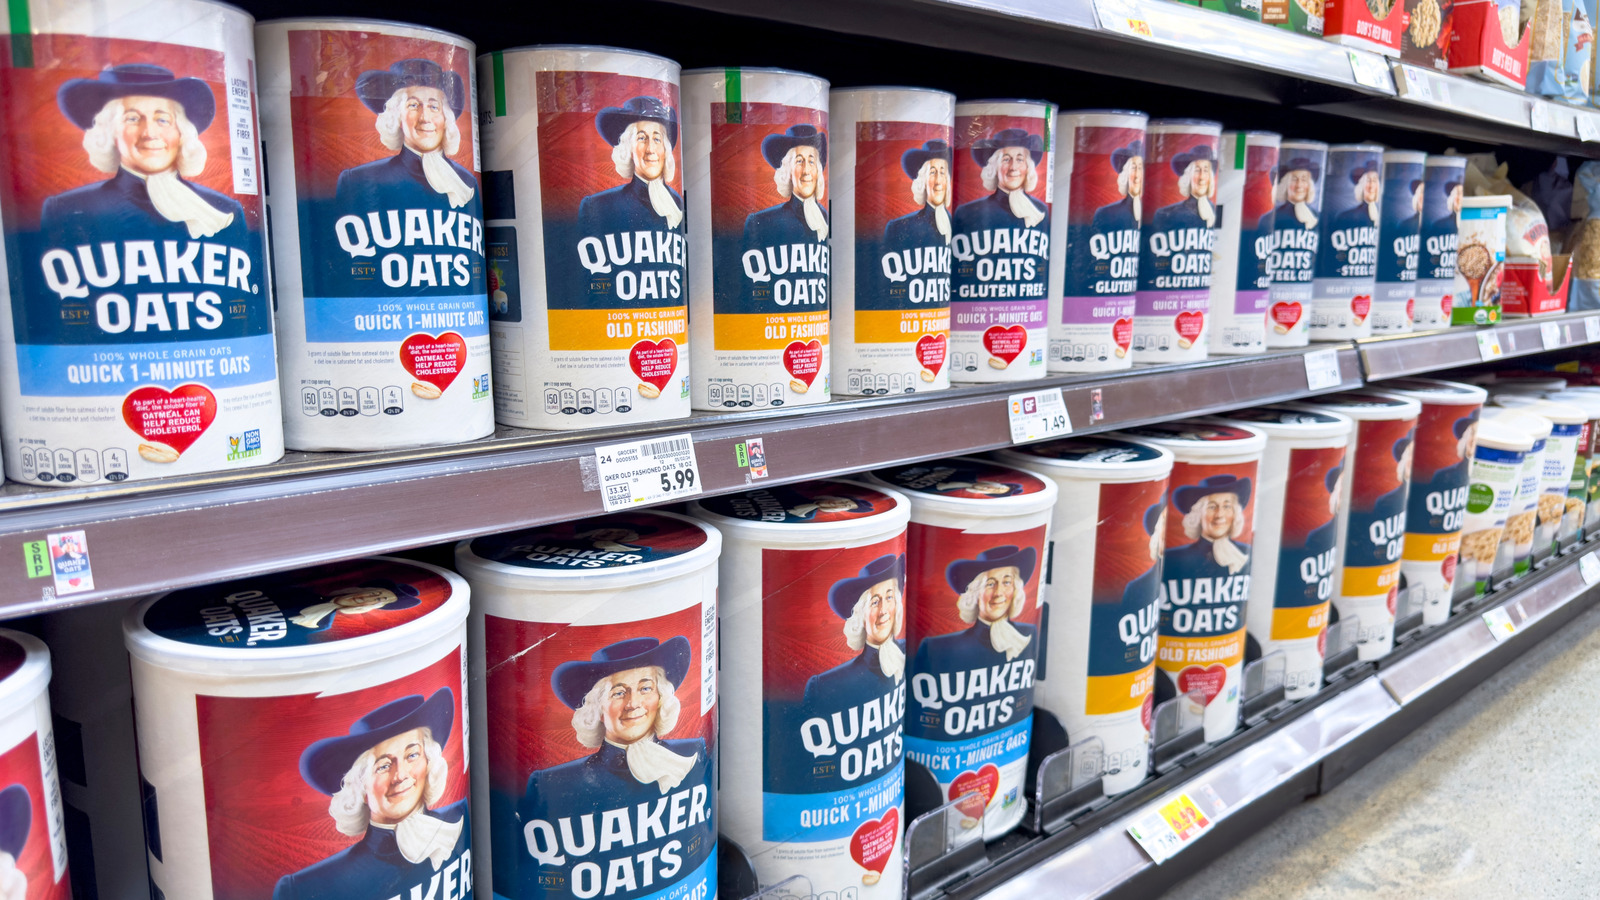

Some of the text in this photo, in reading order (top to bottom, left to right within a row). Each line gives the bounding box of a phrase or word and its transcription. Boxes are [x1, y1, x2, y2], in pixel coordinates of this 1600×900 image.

[232, 87, 249, 98] ENERGY
[237, 130, 250, 139] FIBER
[335, 209, 485, 258] QUAKER
[1331, 226, 1377, 251] QUAK
[951, 228, 1049, 262] QUAKER
[1089, 229, 1140, 260] QUAK
[1149, 228, 1214, 257] QUAKE
[1393, 234, 1420, 257] QUA
[41, 240, 252, 300] QUAKER
[381, 253, 470, 288] OATS
[976, 257, 1036, 282] OATS
[1171, 252, 1211, 274] OATS
[1341, 265, 1369, 276] STEEL
[1155, 275, 1198, 288] GLUTEN
[1270, 269, 1296, 281] TEEL
[615, 270, 681, 301] OATS
[773, 278, 827, 306] OATS
[908, 278, 951, 304] OATS
[959, 283, 1043, 298] GLUTEN FREE
[1095, 280, 1132, 293] GLUTEN
[96, 291, 223, 334] OATS
[229, 304, 247, 314] 1877
[377, 301, 475, 312] 100% WHOLE GRAIN OATS
[1093, 307, 1115, 318] QUICK
[1153, 300, 1177, 310] QUICK
[354, 310, 484, 331] QUICK 1-MINUTE OATS
[607, 312, 630, 321] 100%
[632, 311, 657, 319] WHOLE
[787, 315, 807, 323] WHOLE
[957, 311, 1043, 324] QUICK 1-MINUTE OATS
[606, 319, 685, 338] OLD FASHIONED
[765, 325, 786, 340] OLD
[900, 320, 920, 333] OLD
[93, 346, 232, 362] 100% WHOLE GRAIN OATS
[414, 354, 443, 362] OATMEAL
[640, 358, 662, 366] OATMEAL
[67, 355, 250, 385] QUICK 1-MINUTE OATS
[433, 360, 457, 368] REDUCE
[641, 364, 654, 372] HELP
[641, 370, 671, 378] CHOLESTEROL
[142, 399, 156, 407] part
[169, 396, 207, 404] heart-healthy
[304, 393, 316, 405] 150
[546, 393, 558, 405] 150
[710, 388, 721, 398] 150
[163, 402, 184, 410] soluble
[1024, 399, 1035, 412] GF
[142, 410, 182, 420] OATMEAL
[143, 416, 201, 428] HELP REDUCE
[1042, 415, 1065, 432] 7.49
[144, 425, 202, 436] CHOLESTEROL
[245, 430, 259, 438] NON
[245, 436, 260, 444] GMO
[22, 453, 33, 468] 150
[600, 455, 612, 464] 24
[617, 448, 637, 456] GROCERY
[605, 473, 619, 481] QKER
[620, 471, 631, 479] OLD
[632, 466, 661, 477] FASHIONED
[662, 463, 676, 471] OATS
[660, 468, 694, 492] 5.99
[1426, 486, 1469, 516] QUA
[1369, 511, 1406, 546] QUA
[31, 543, 43, 576] SRP
[511, 544, 643, 564] QUAKER
[526, 552, 605, 568] OATS
[1300, 547, 1336, 584] QUA
[199, 606, 243, 637] OATS
[224, 590, 287, 644] QUAKER
[1118, 597, 1159, 646] QUA
[1172, 605, 1239, 633] OATS
[1140, 630, 1158, 663] OA
[1160, 642, 1239, 662] OLD FASHIONED
[912, 658, 1035, 710] QUAKER
[800, 680, 905, 758] QUAKE
[944, 695, 1015, 736] OATS
[840, 724, 903, 781] OATS
[955, 741, 1004, 769] 1-MINUTE
[1006, 730, 1028, 751] OATS
[800, 777, 902, 828] QUICK 1-MINUTE
[833, 794, 855, 805] 100%
[858, 783, 881, 798] WHOLE
[523, 783, 708, 866] QUAKER
[687, 836, 701, 853] 1877
[571, 840, 682, 899] OATS
[669, 883, 688, 900] OATS
